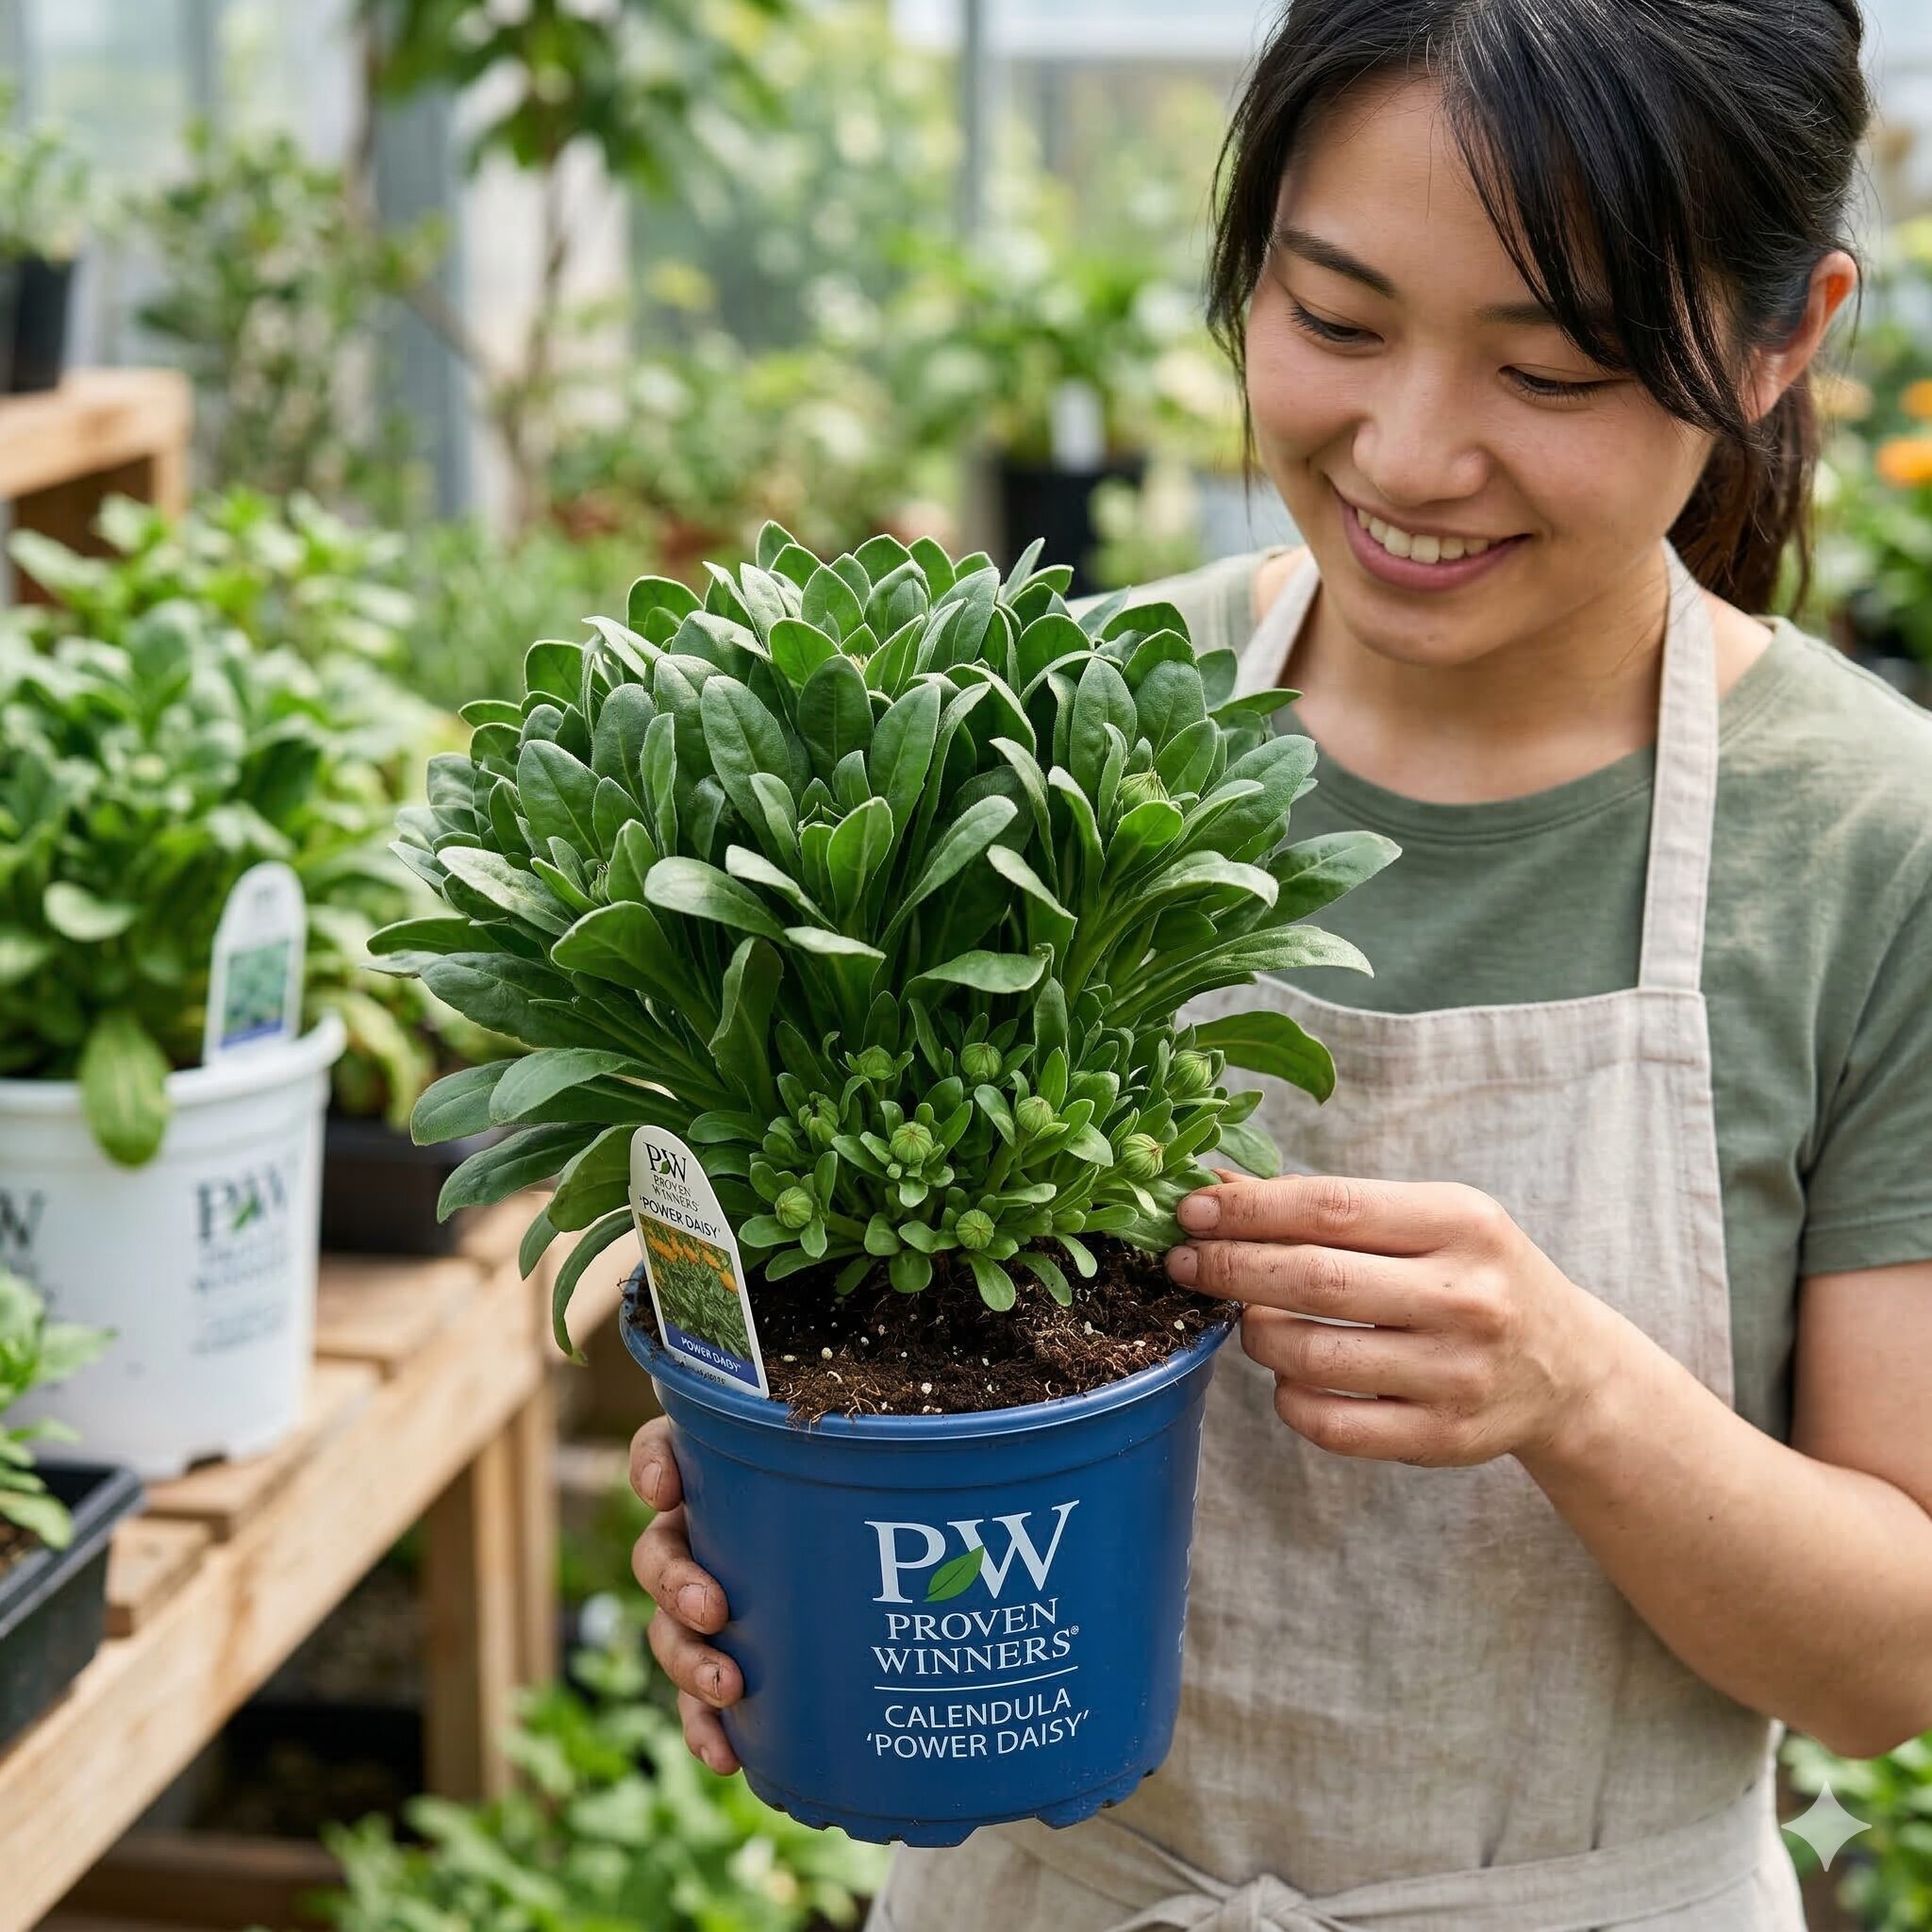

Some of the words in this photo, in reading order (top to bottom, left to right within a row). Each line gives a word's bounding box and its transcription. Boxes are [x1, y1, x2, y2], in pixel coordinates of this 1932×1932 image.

[642, 1141, 687, 1184] PW
[653, 1174, 691, 1197] PROVEN
[639, 1195, 684, 1225] 'POWER
[685, 1214, 721, 1239] DAISY'
[864, 1499, 1079, 1605] PW
[884, 1597, 1059, 1641] PROVEN
[884, 1688, 1072, 1729] CALENDULA
[866, 1732, 988, 1758] 'POWER
[997, 1708, 1090, 1755] DAISY'
